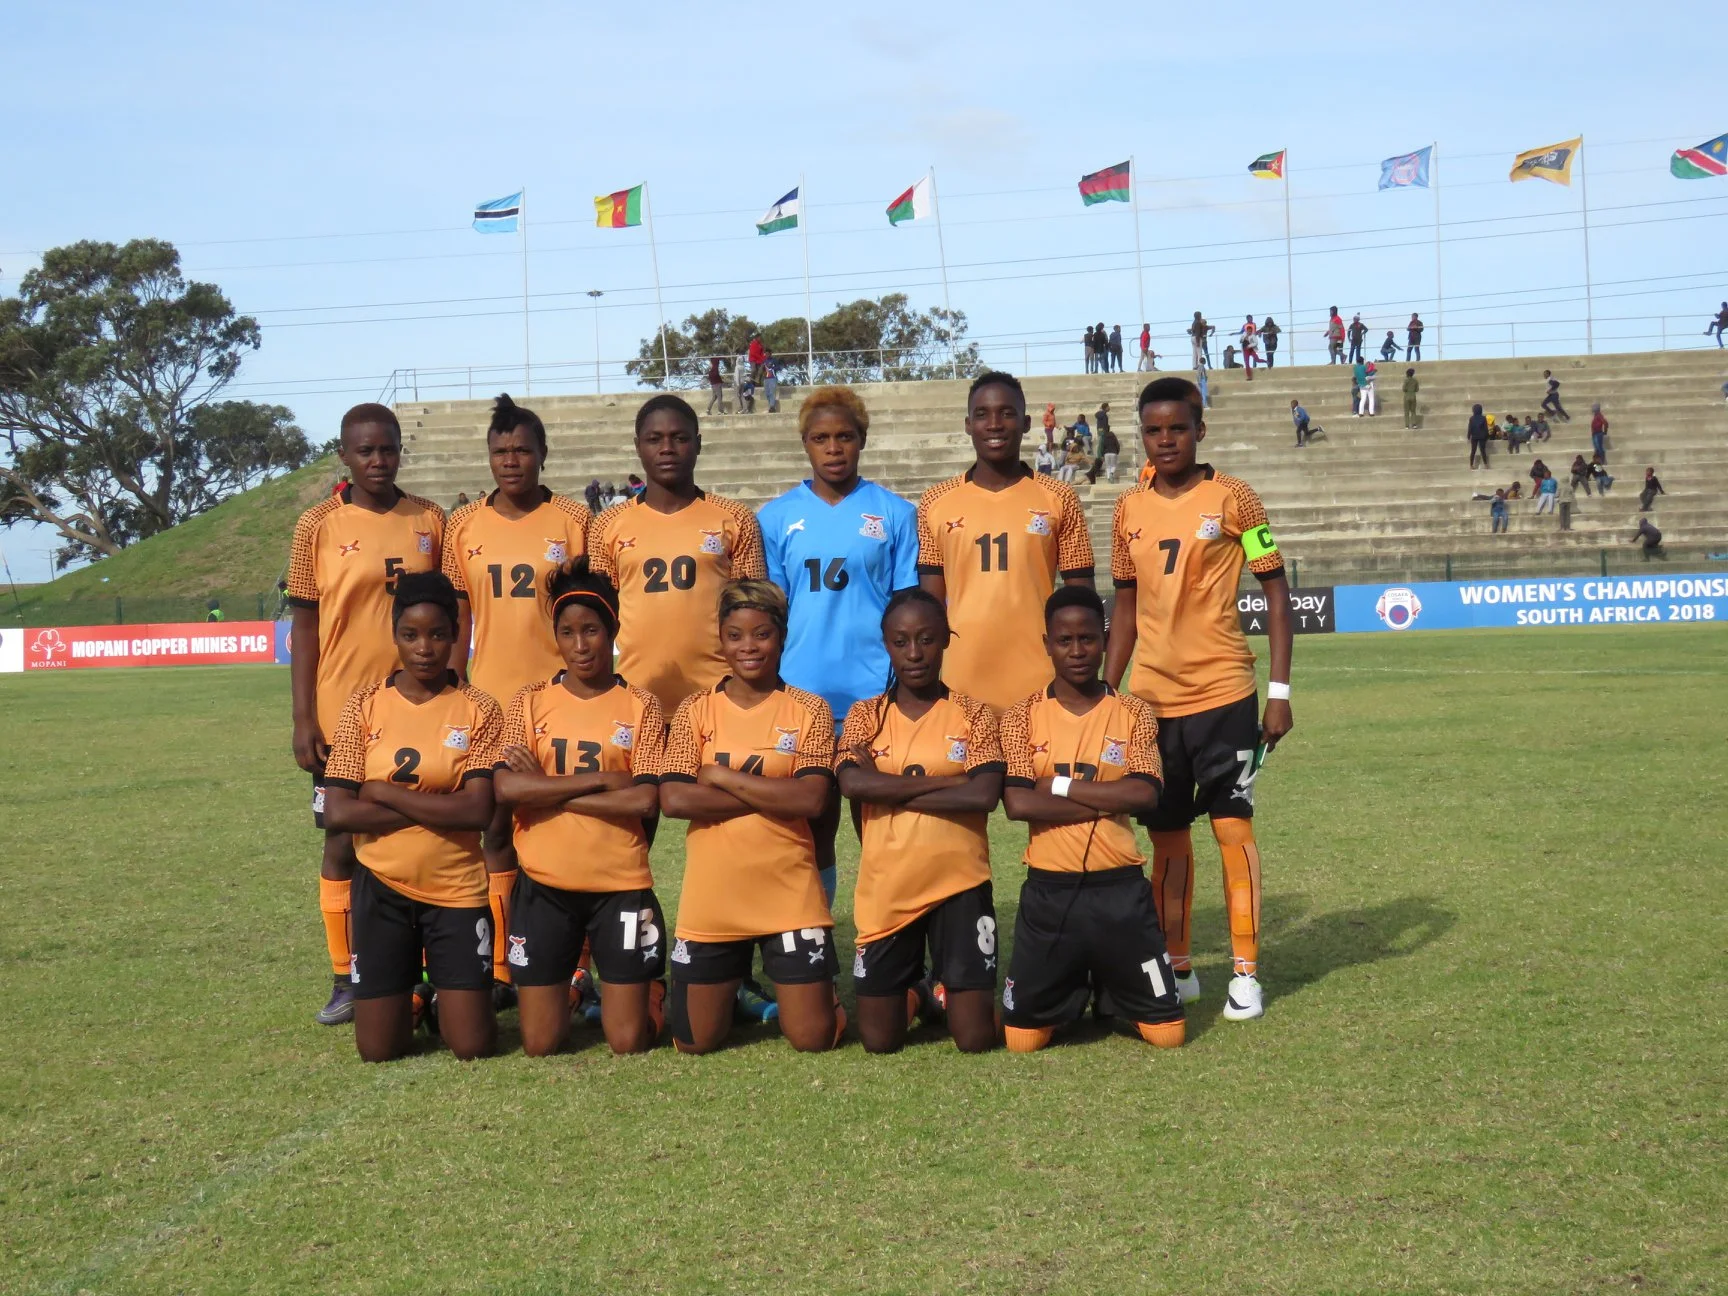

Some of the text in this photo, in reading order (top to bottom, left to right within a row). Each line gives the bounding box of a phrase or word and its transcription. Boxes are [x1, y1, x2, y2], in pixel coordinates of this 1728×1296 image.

[975, 532, 1008, 572] 11
[1257, 527, 1274, 548] C
[643, 555, 696, 593] 20
[804, 557, 849, 592] 16
[1158, 538, 1181, 575] 7
[385, 557, 406, 596] 5
[487, 563, 536, 598] 12
[1460, 578, 1728, 604] WOMEN'S CHAMPIONS
[1516, 604, 1715, 625] SOUTH AFRICA 2018
[72, 635, 268, 658] MOPANI COPPER MINES PLC
[391, 747, 421, 784] 2
[551, 738, 602, 775] 13
[476, 917, 492, 955] 2
[620, 908, 659, 950] 13
[976, 916, 996, 955] 8
[1141, 952, 1170, 998] 1
